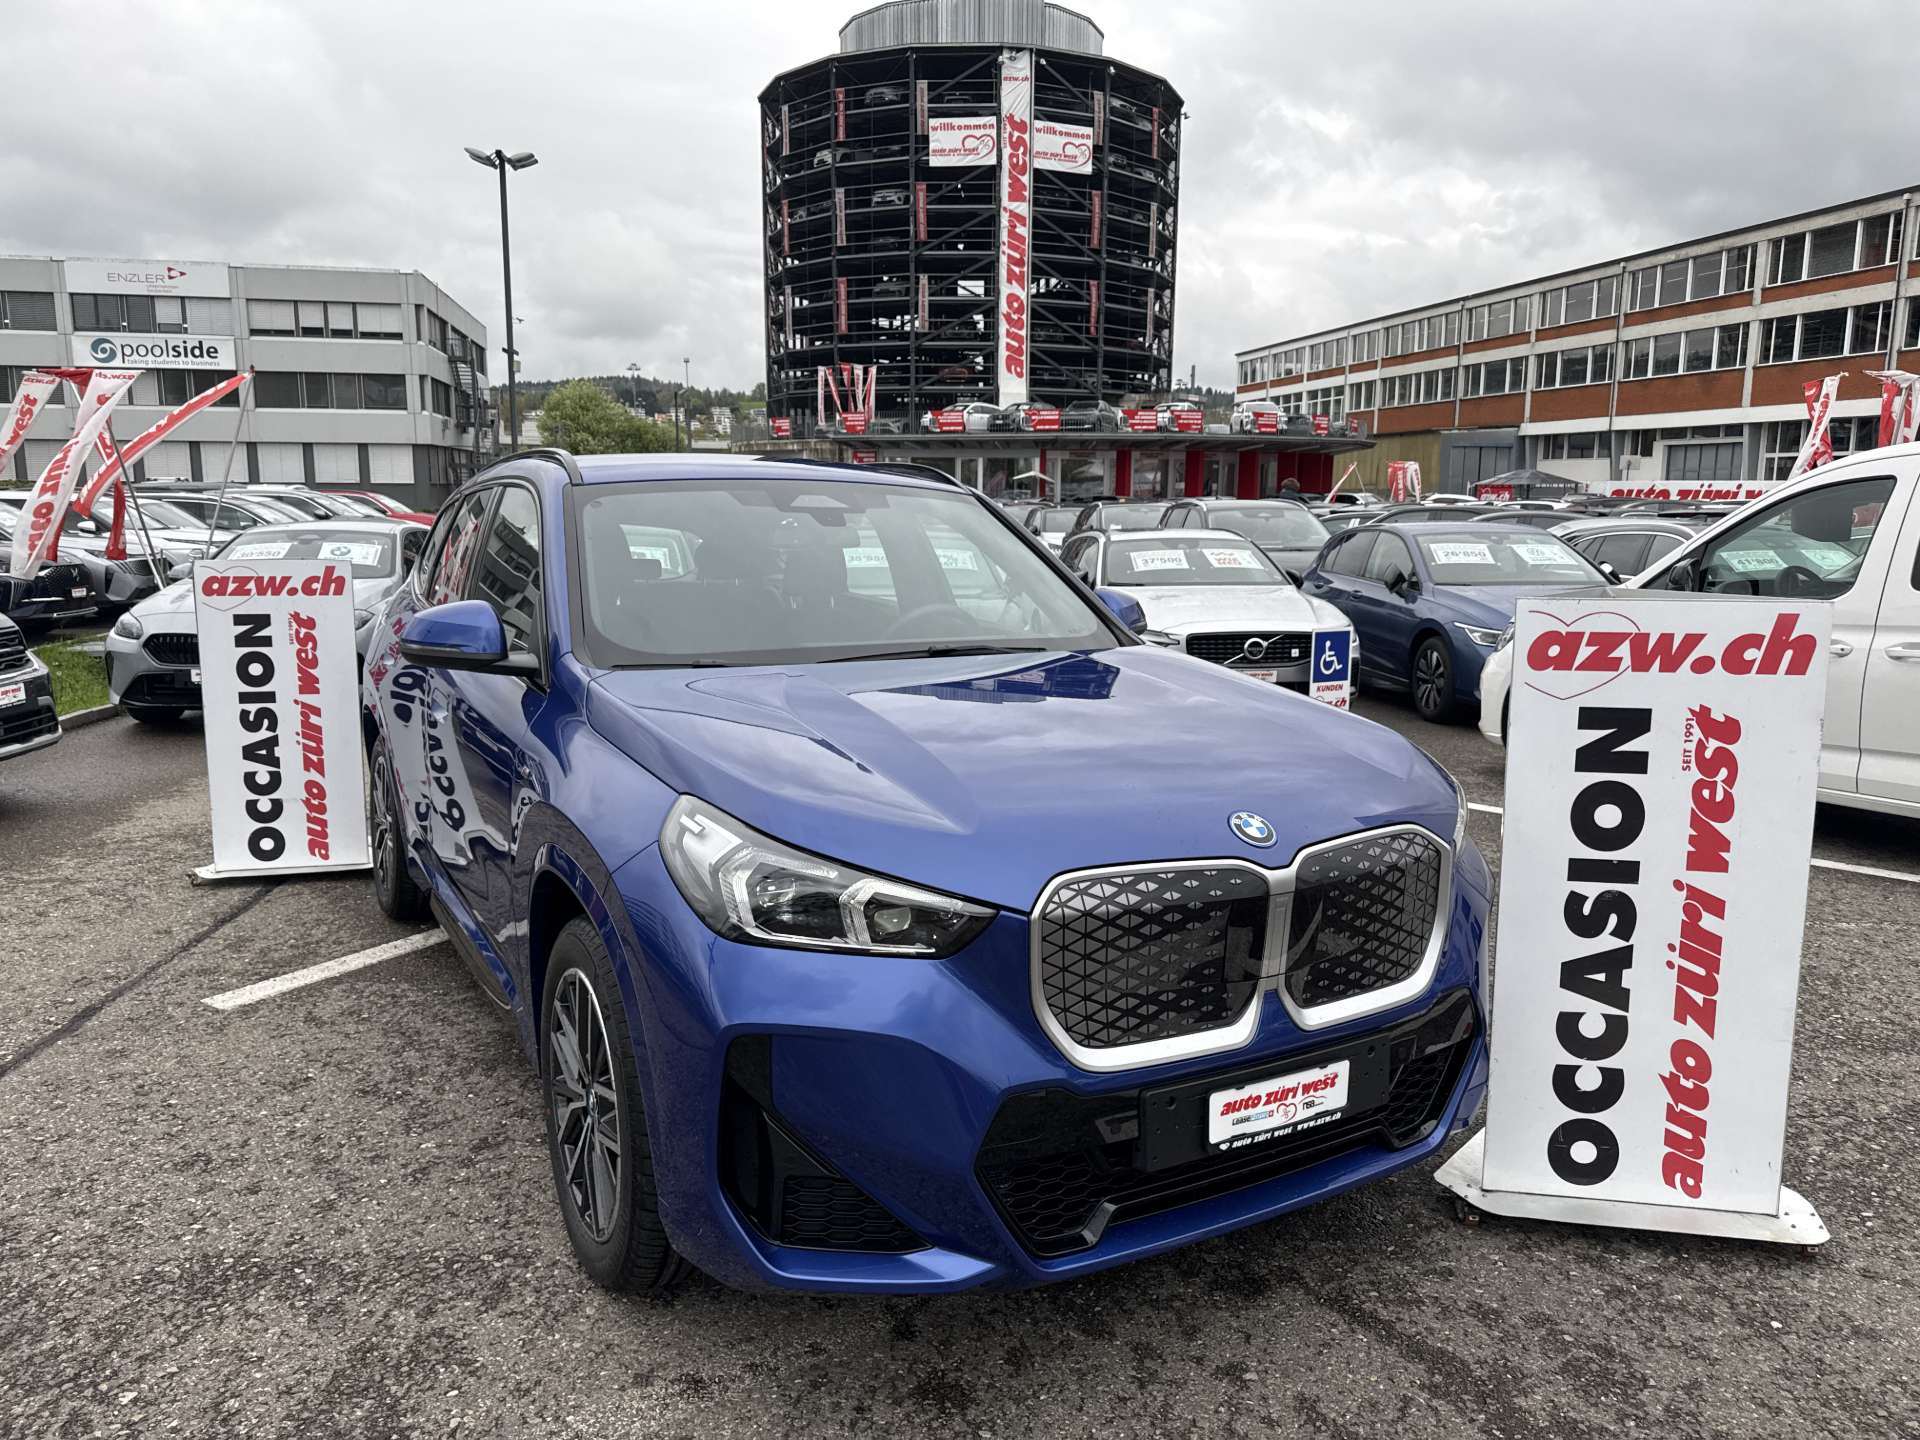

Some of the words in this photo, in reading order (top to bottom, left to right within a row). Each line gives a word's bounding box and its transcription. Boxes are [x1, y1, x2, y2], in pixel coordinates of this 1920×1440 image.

[930, 122, 995, 132] willkommen
[1035, 126, 1092, 140] willkommen
[1006, 113, 1029, 203] west
[107, 272, 166, 284] ENZLER
[1002, 206, 1028, 292] züri
[120, 339, 219, 364] poolside
[127, 358, 149, 367] taking
[1002, 293, 1026, 379] auto
[5, 393, 38, 446] west
[201, 565, 346, 597] azw.ch
[287, 610, 321, 695] west
[1526, 612, 1817, 677] azw.ch
[1316, 683, 1344, 693] KUNDEN
[232, 613, 286, 862] OCCASION
[293, 698, 326, 778] züri
[1682, 742, 1692, 772] SEIT
[1684, 716, 1694, 740] 1991
[1685, 703, 1744, 874] west
[301, 779, 330, 862] auto
[1547, 706, 1653, 1187] OCCASION
[1665, 879, 1728, 1041] züri
[1220, 1093, 1262, 1117] auto
[1262, 1081, 1301, 1107] züri
[1301, 1072, 1339, 1097] west
[1656, 1037, 1714, 1200] auto
[1231, 1137, 1253, 1149] auto
[1252, 1130, 1273, 1143] züri
[1273, 1126, 1293, 1138] west
[1297, 1112, 1342, 1131] www.azw.ch
